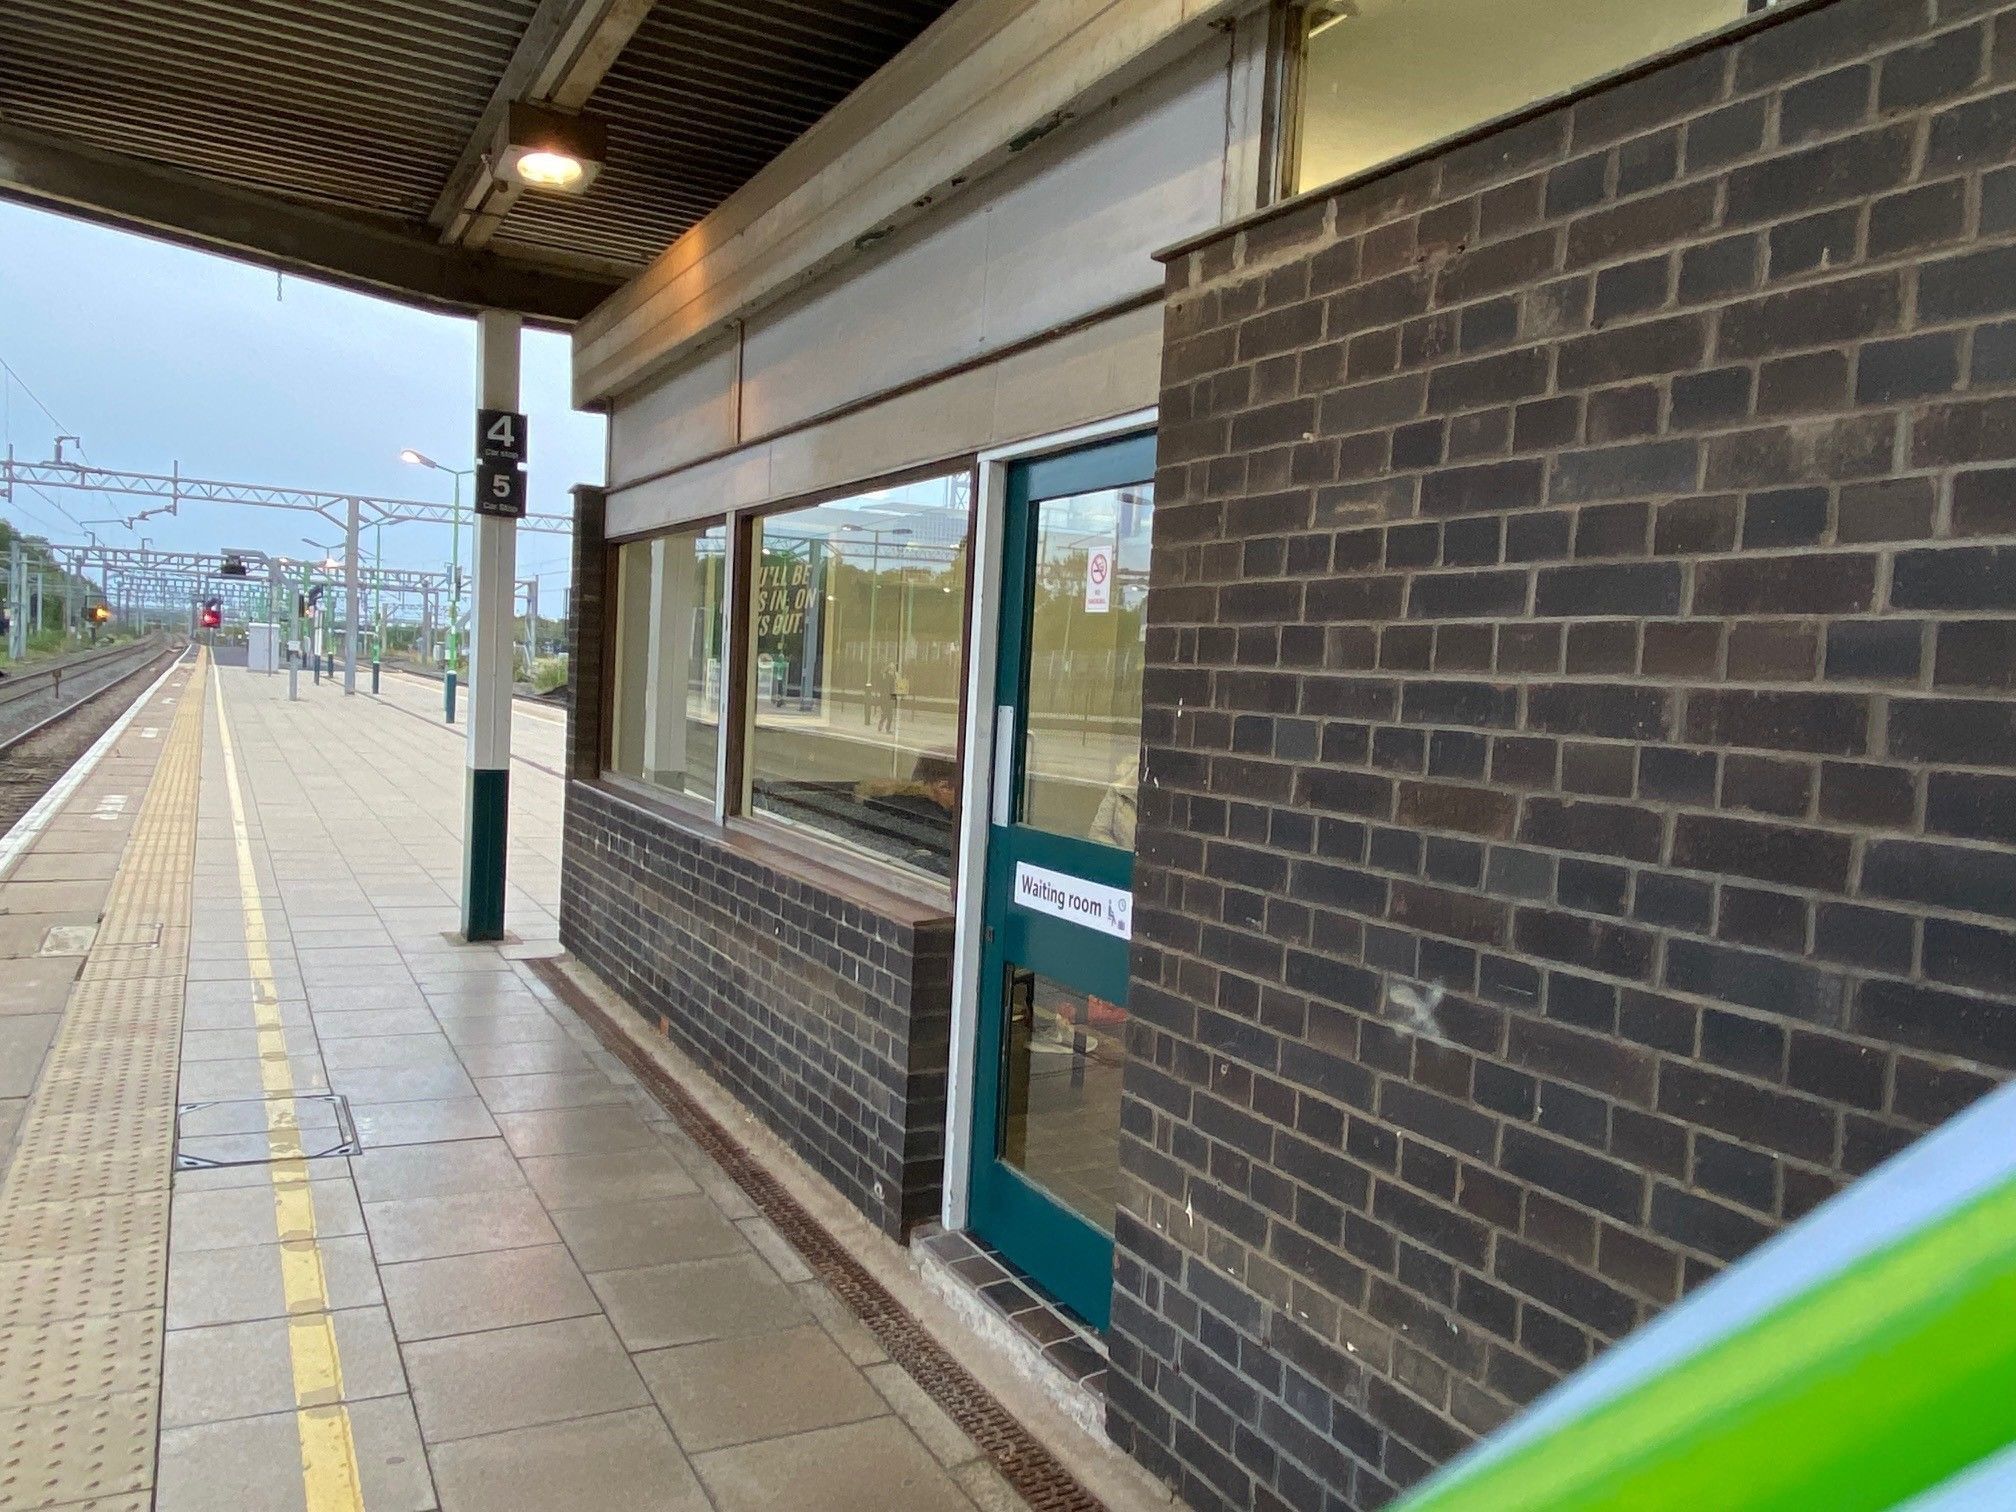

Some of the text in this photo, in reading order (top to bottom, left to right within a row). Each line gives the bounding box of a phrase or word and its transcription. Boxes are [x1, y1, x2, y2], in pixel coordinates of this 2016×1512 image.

[487, 415, 515, 448] 4
[492, 474, 511, 498] 5
[791, 564, 813, 586] BE
[795, 587, 817, 609] ON
[1022, 873, 1102, 917] Waiting room
